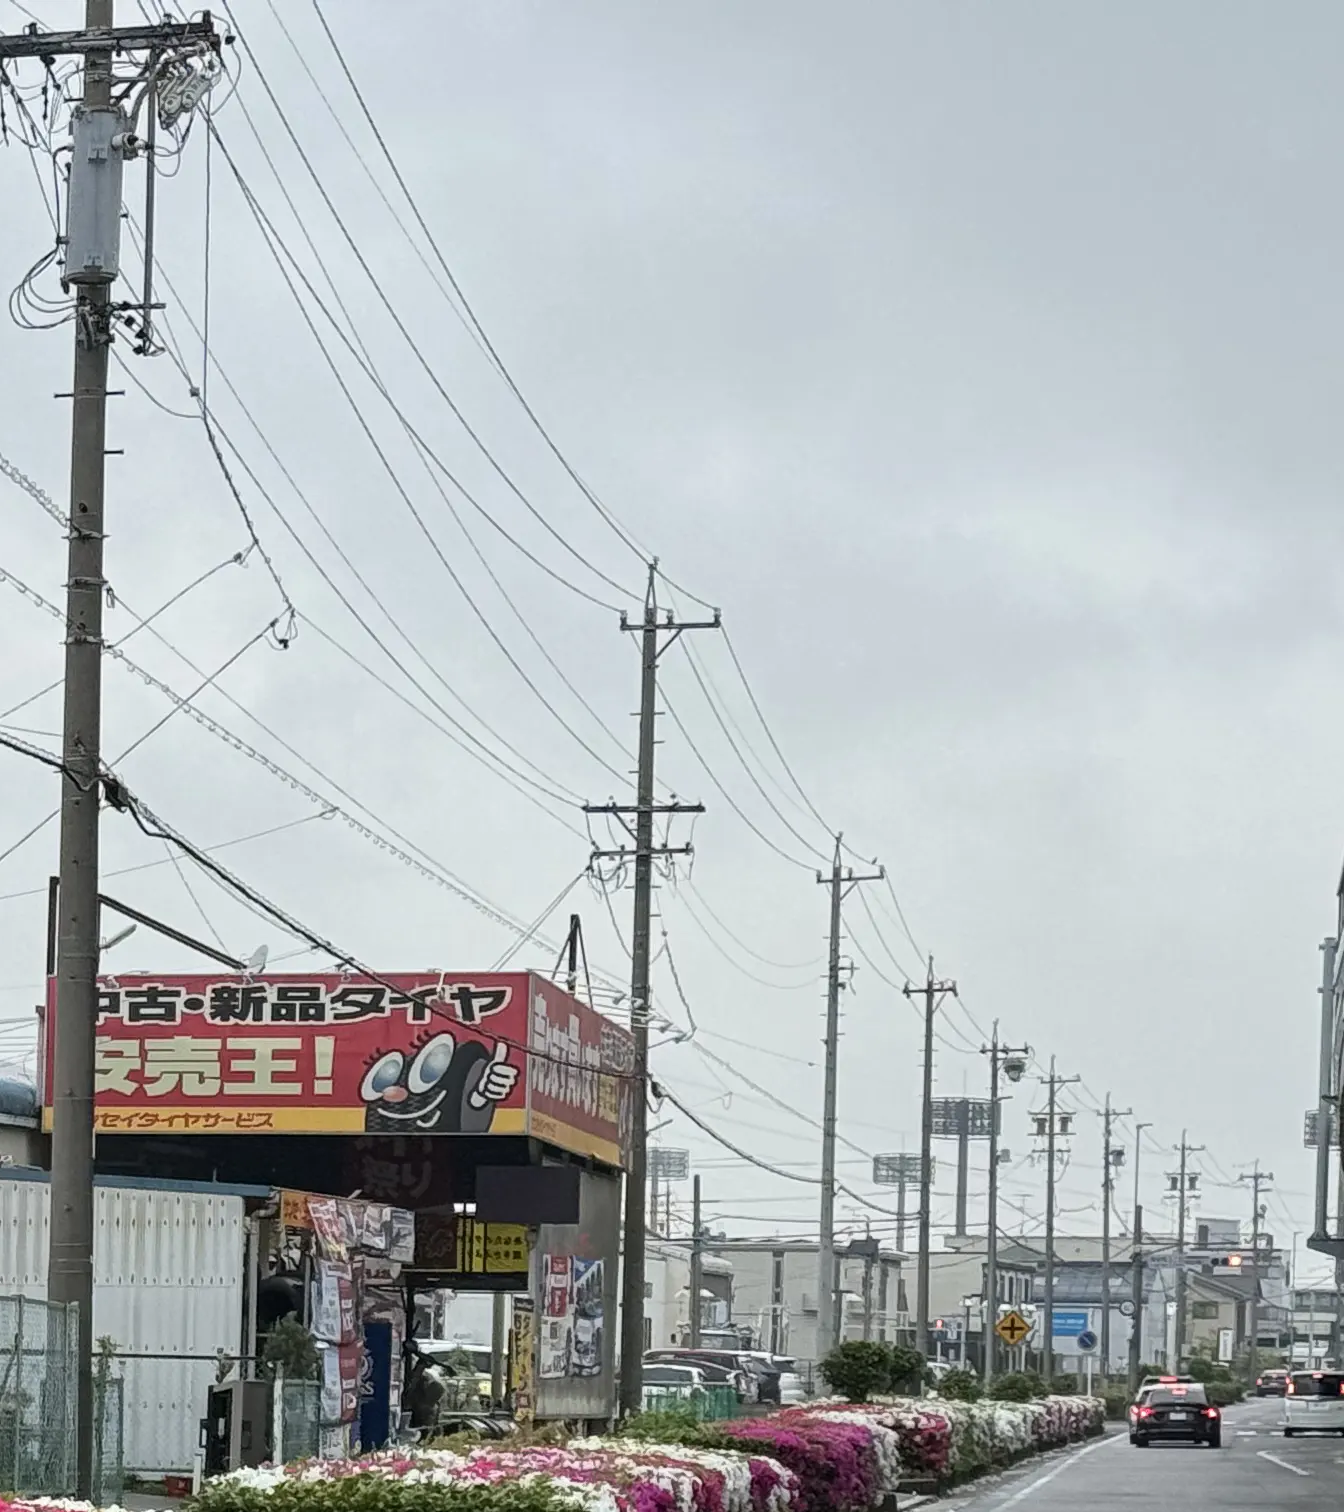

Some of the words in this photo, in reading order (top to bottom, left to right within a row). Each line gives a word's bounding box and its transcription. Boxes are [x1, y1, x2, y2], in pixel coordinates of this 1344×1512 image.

[95, 1036, 335, 1097] 安売王!
[95, 1111, 274, 1129] セイタイヤサービス
